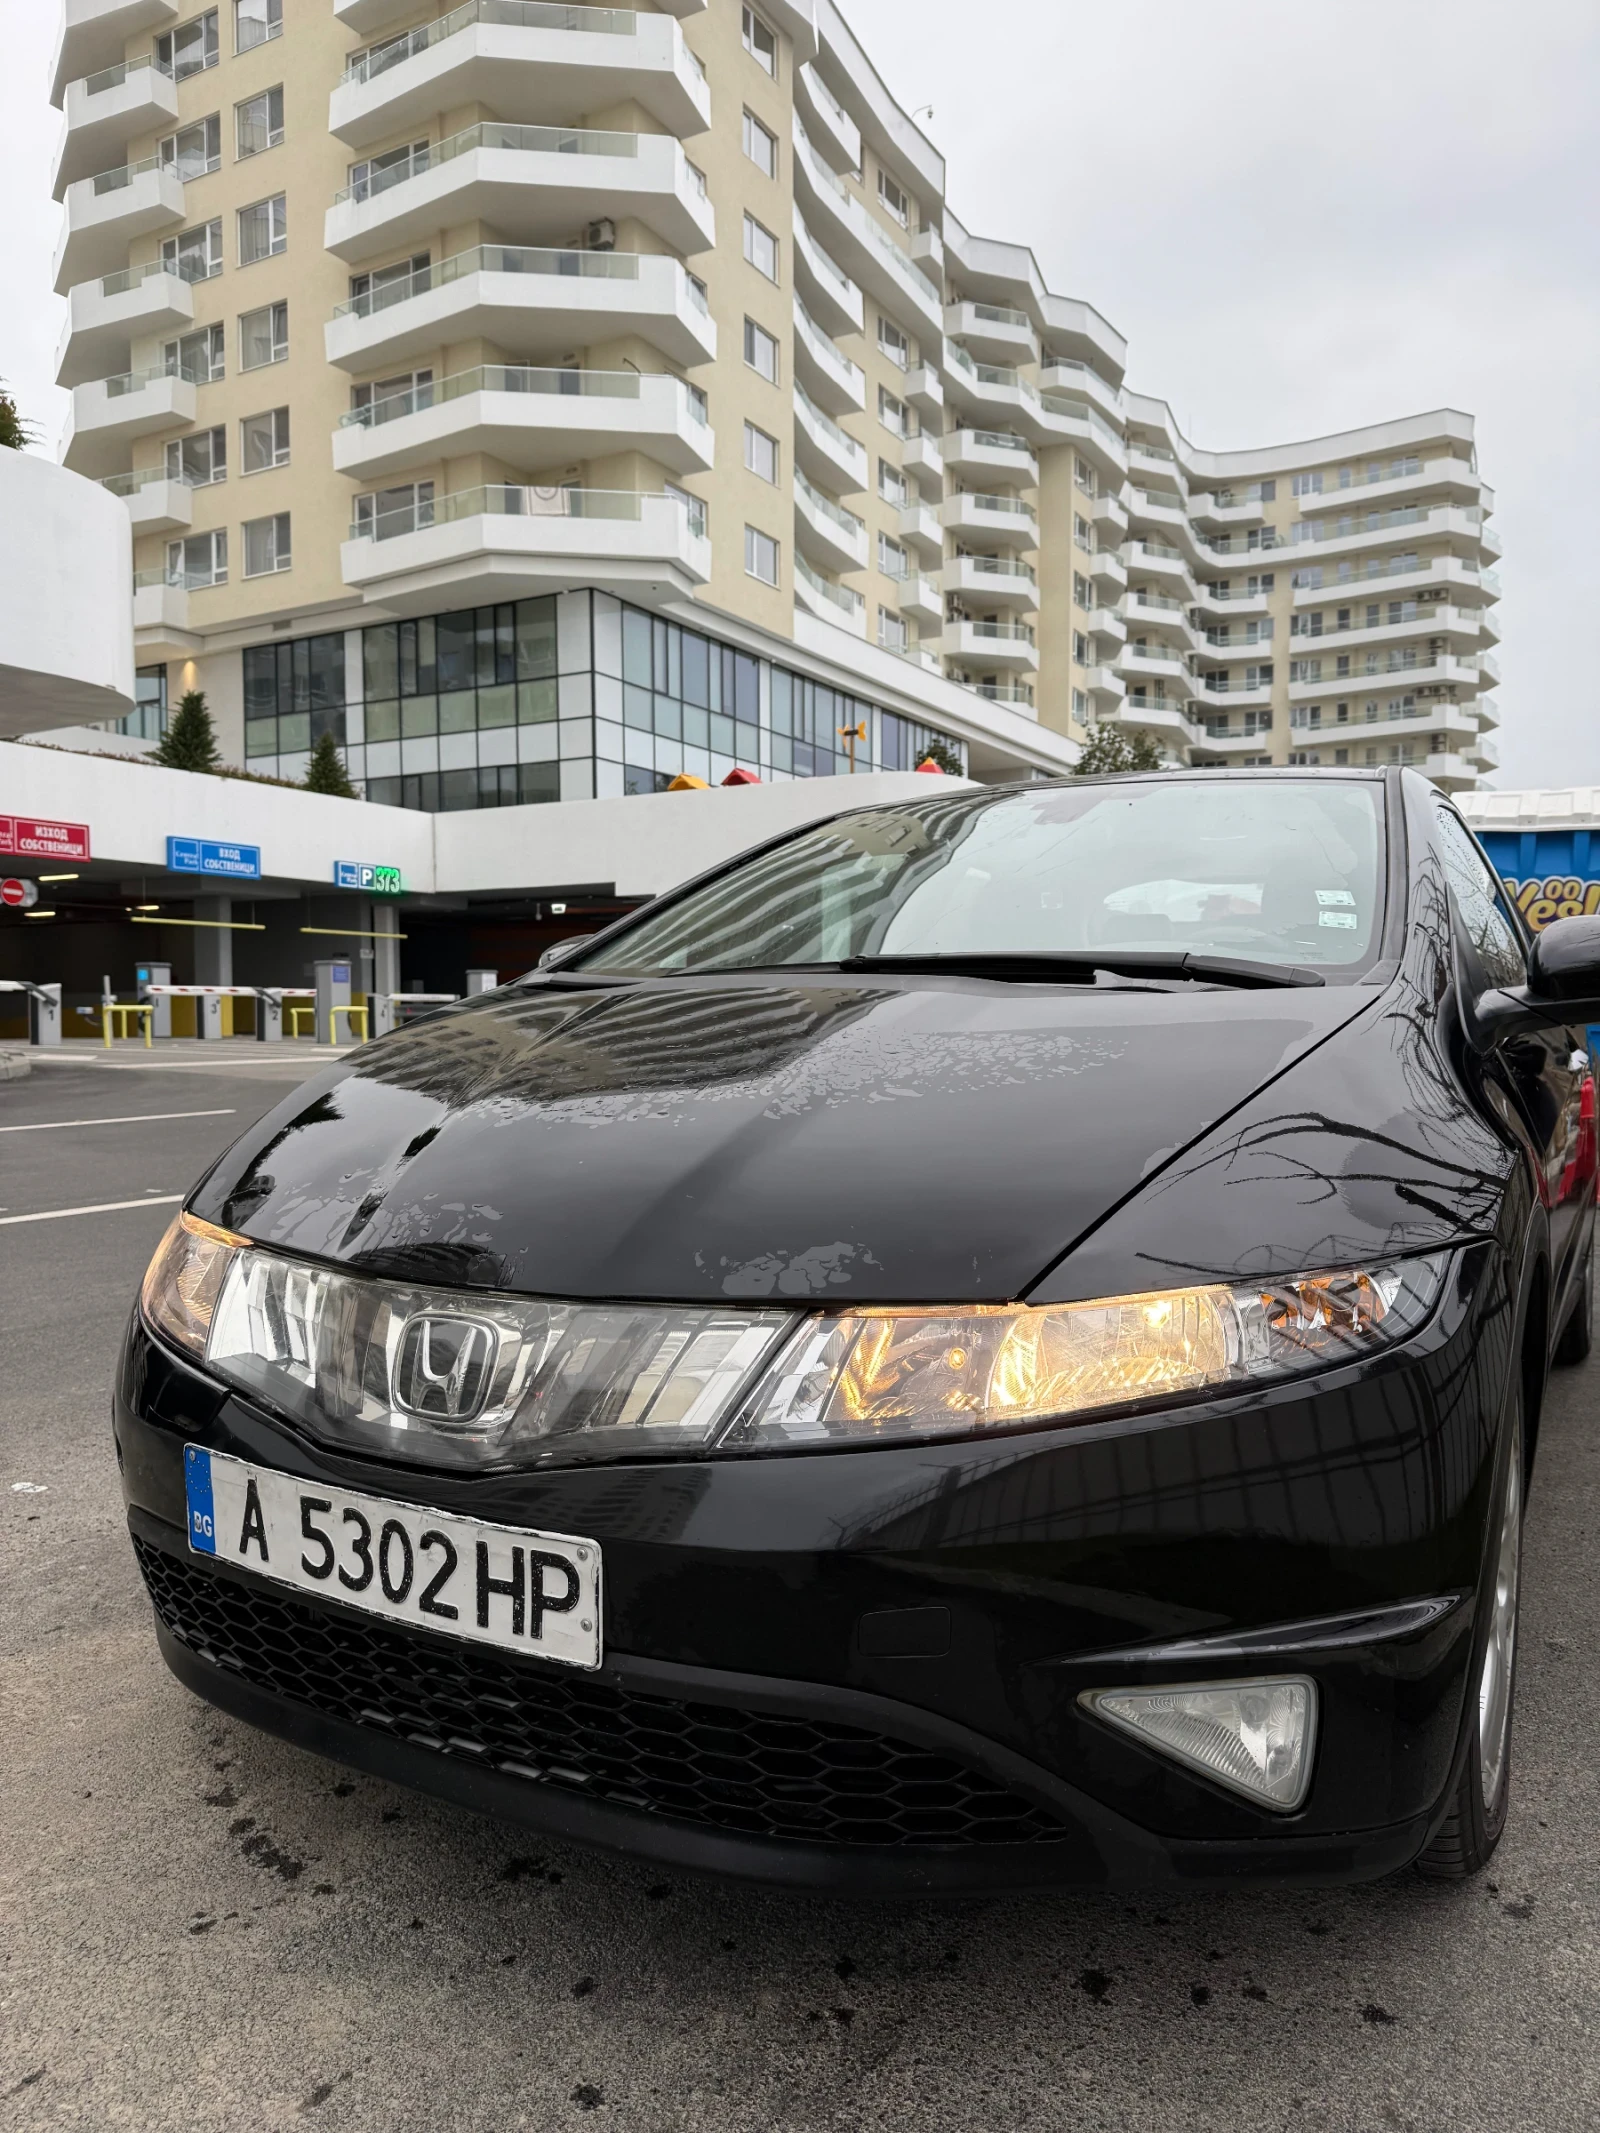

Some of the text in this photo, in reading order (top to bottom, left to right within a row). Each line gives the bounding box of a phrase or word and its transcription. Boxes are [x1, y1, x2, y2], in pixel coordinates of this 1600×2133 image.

[35, 825, 69, 842] ИЗХОД
[20, 838, 83, 855] СОБСТВЕНИЦИ
[218, 847, 241, 861] ВХОД
[204, 858, 255, 873] СОБСТВЕНИЦИ
[362, 868, 373, 885] P
[376, 867, 400, 893] 373
[272, 1010, 279, 1021] 2
[193, 1510, 213, 1538] BG
[239, 1478, 580, 1640] A 5302 HP
